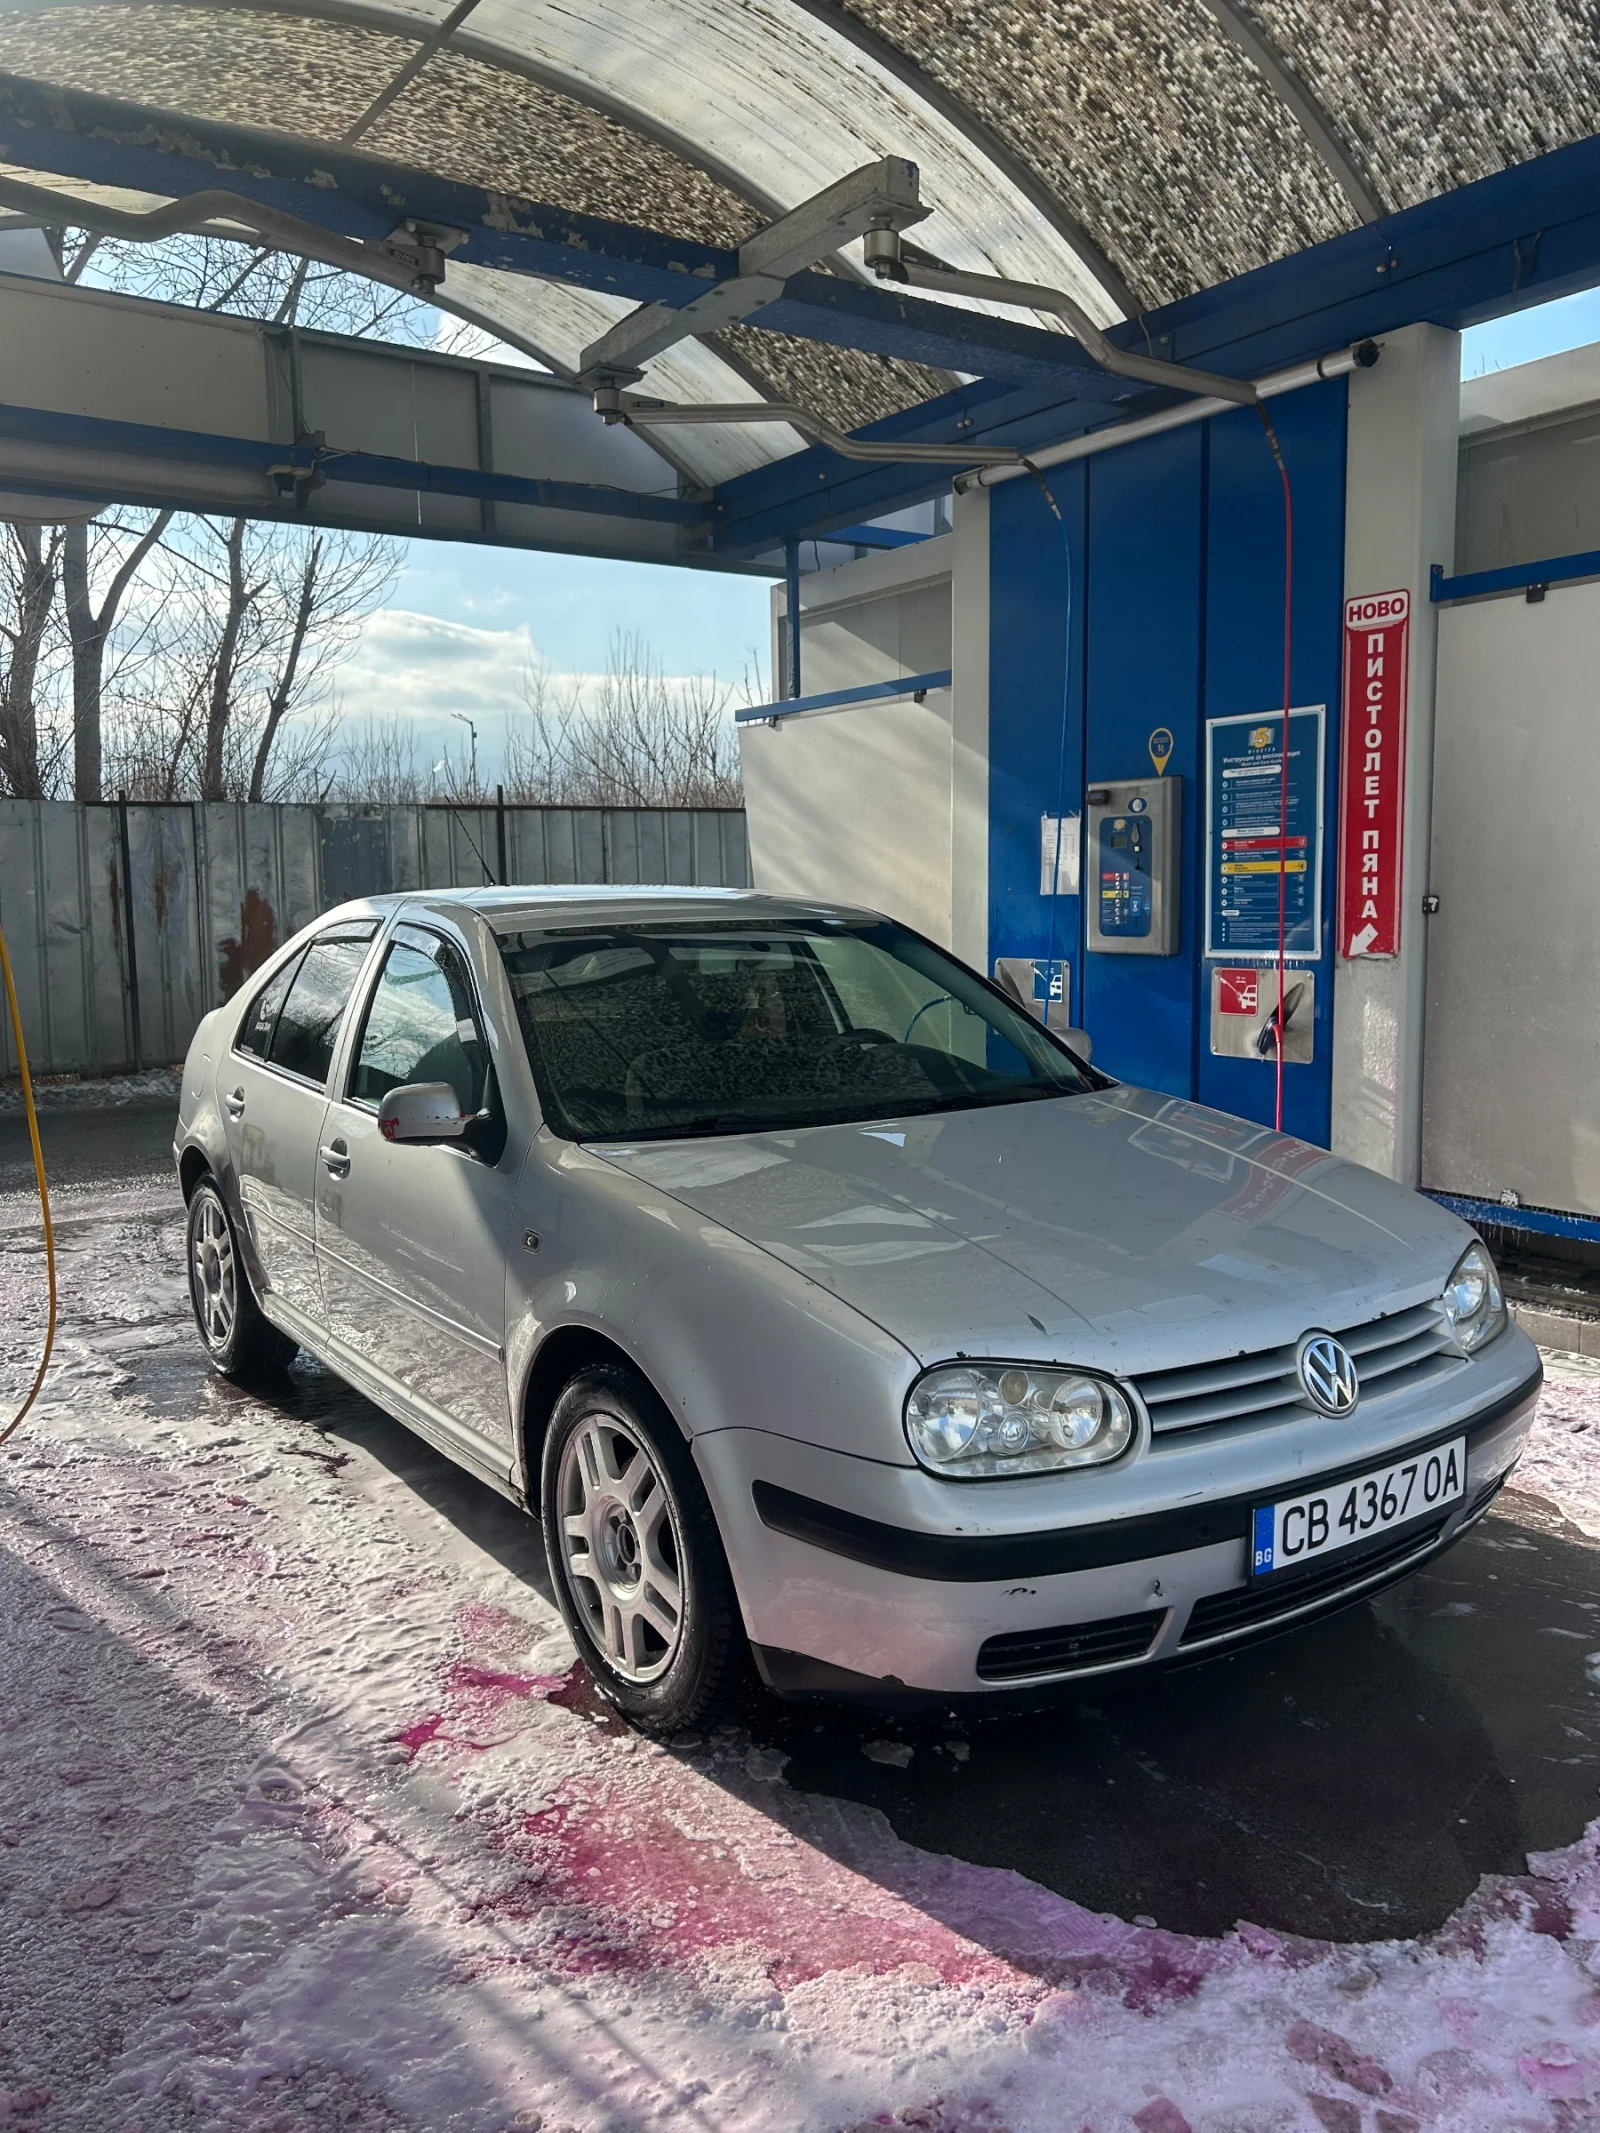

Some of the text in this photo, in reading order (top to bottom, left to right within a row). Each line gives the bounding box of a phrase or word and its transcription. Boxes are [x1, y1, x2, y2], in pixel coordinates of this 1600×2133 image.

[1348, 598, 1404, 622] НОВО
[1253, 727, 1269, 748] 5
[1361, 633, 1384, 918] ПИСТОЛЕТ ПЯНА
[1282, 1448, 1458, 1557] CB 4367 OA
[1255, 1548, 1272, 1566] BG
